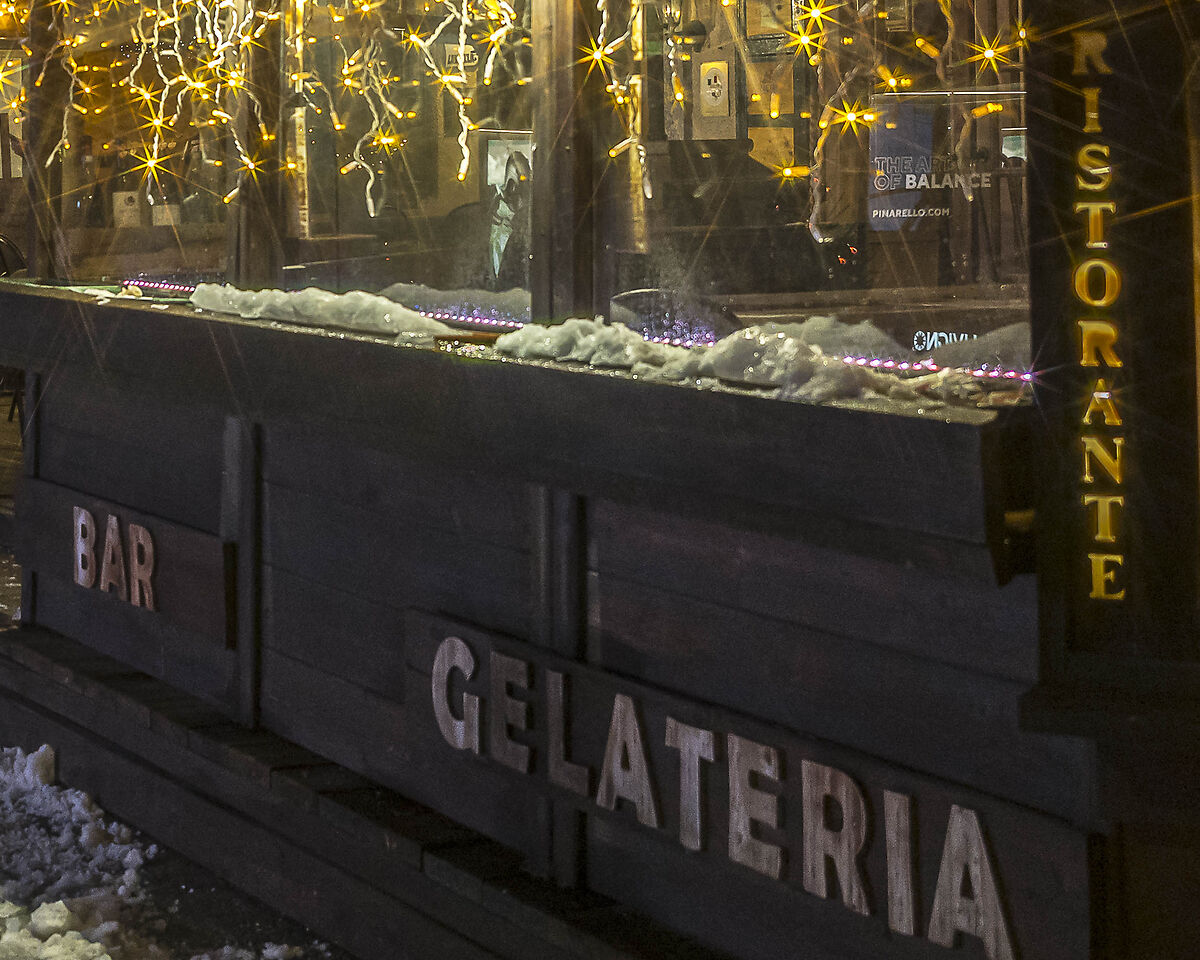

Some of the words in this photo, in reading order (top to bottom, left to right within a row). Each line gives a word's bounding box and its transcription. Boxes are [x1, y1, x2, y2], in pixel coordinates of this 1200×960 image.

[873, 174, 902, 191] OF
[905, 173, 992, 190] BALANCE
[874, 156, 913, 173] THE
[872, 208, 950, 219] PINARELLO.COM
[1071, 30, 1126, 602] RISTORANTE
[73, 505, 158, 612] BAR
[430, 636, 1016, 960] GELATERIA
